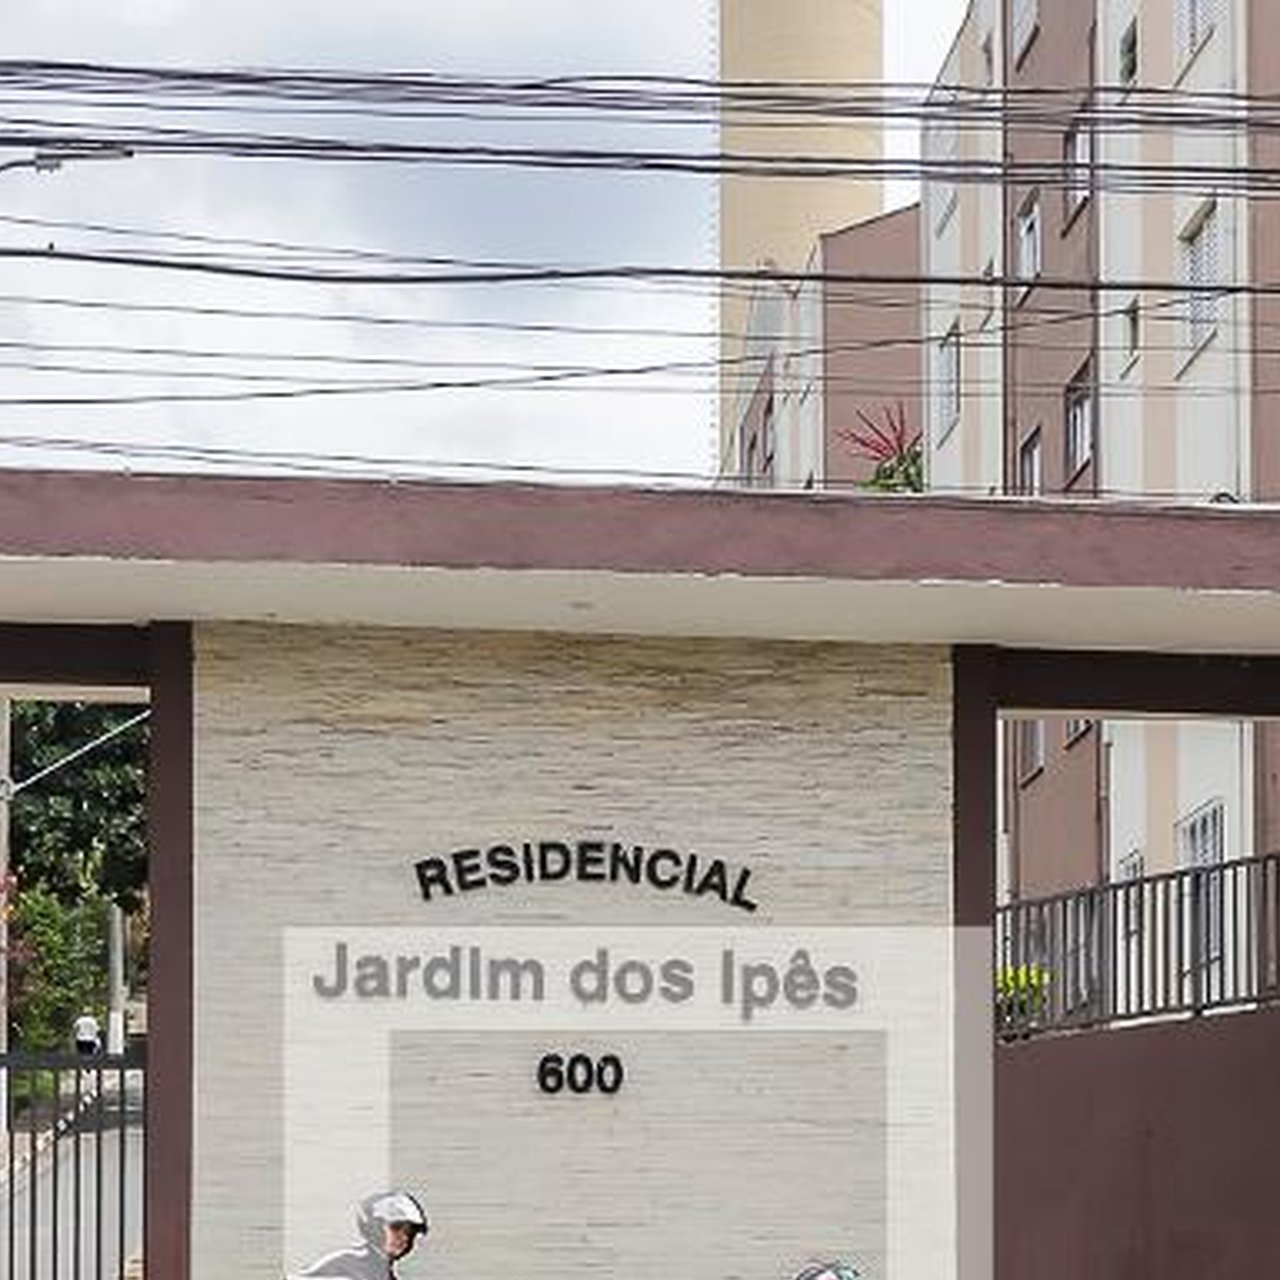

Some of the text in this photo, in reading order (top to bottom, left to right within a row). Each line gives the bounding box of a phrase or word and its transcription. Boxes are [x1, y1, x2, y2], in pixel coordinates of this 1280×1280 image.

[415, 841, 758, 912] RESIDENCIAL
[568, 947, 695, 1006] dos
[720, 948, 859, 1022] Ipês
[536, 1053, 624, 1095] 600
